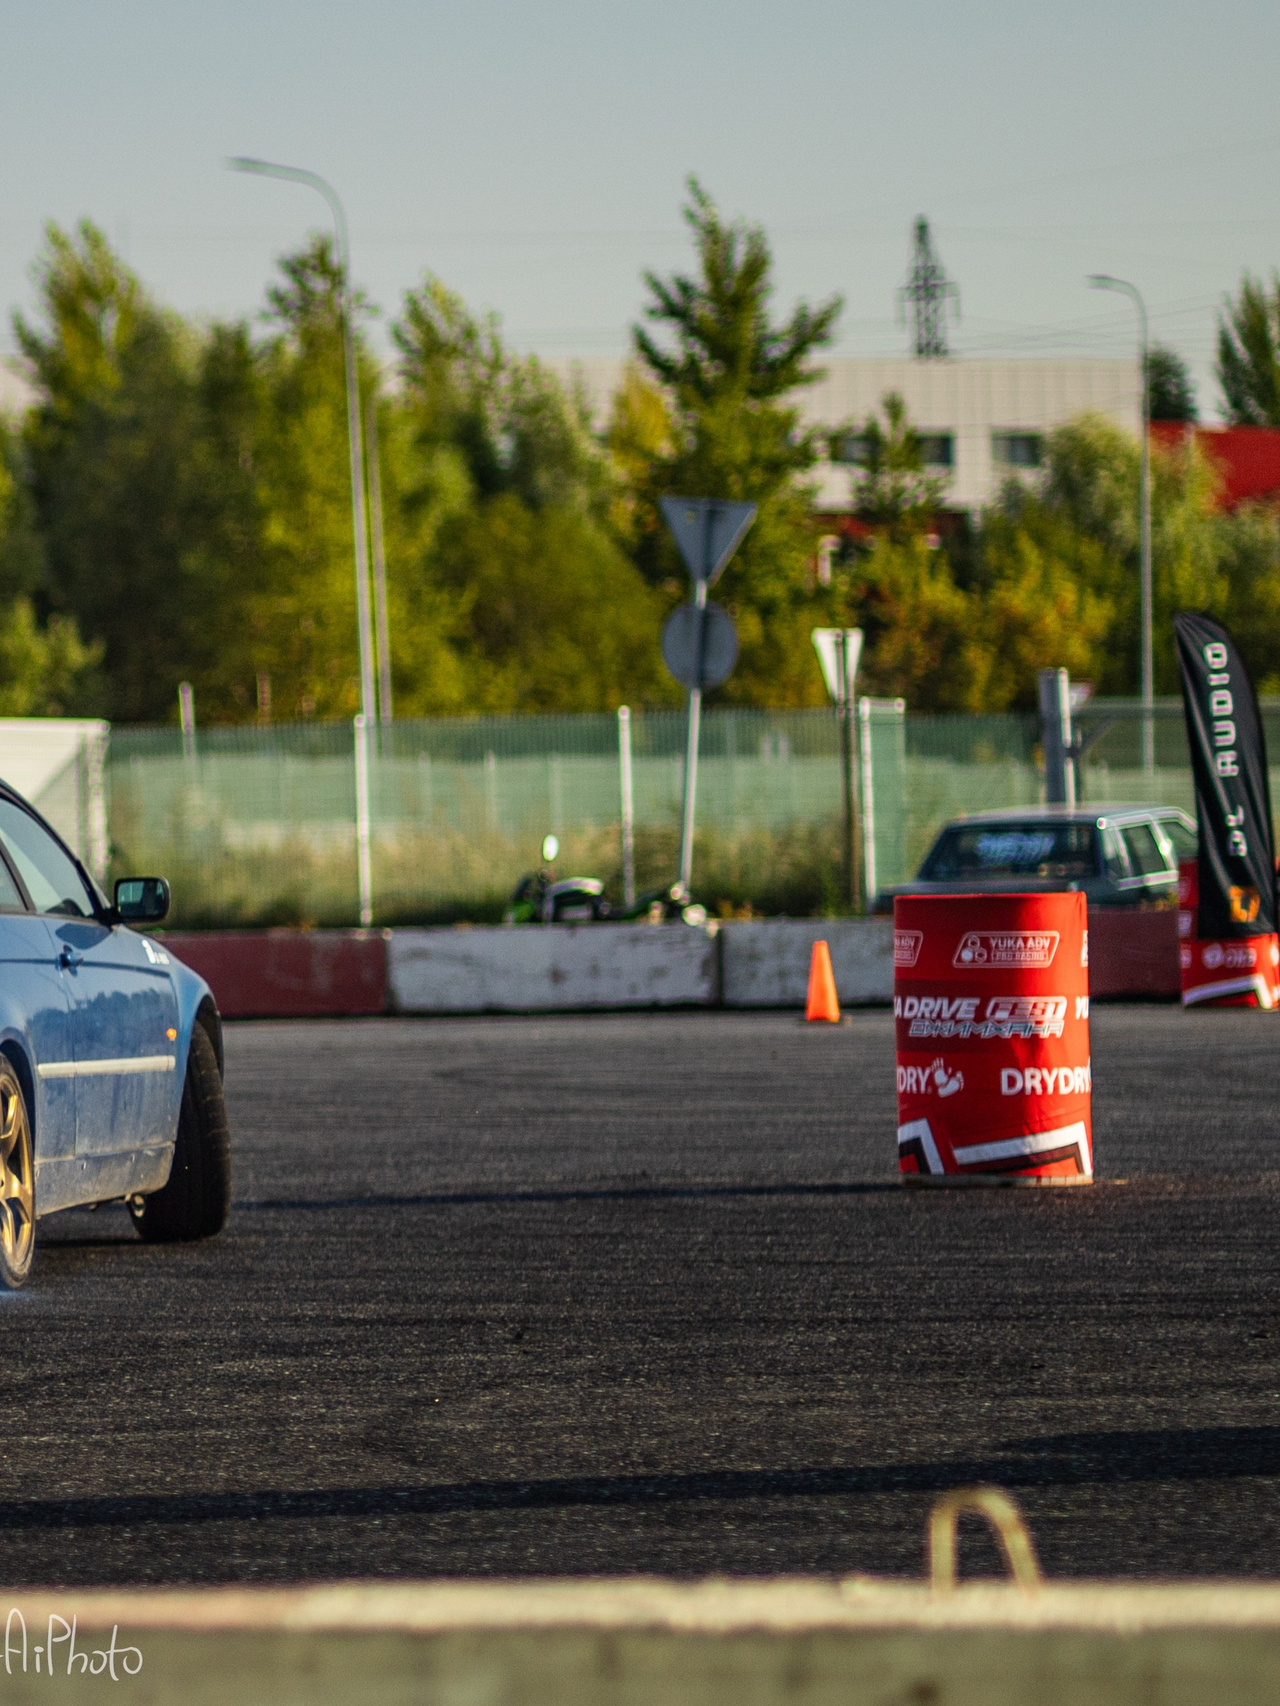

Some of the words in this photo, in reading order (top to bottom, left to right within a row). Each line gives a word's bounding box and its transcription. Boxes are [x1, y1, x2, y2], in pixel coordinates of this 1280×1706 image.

[1203, 642, 1240, 777] AUDIO
[990, 937, 1025, 949] YUKA
[1026, 937, 1050, 949] ADV
